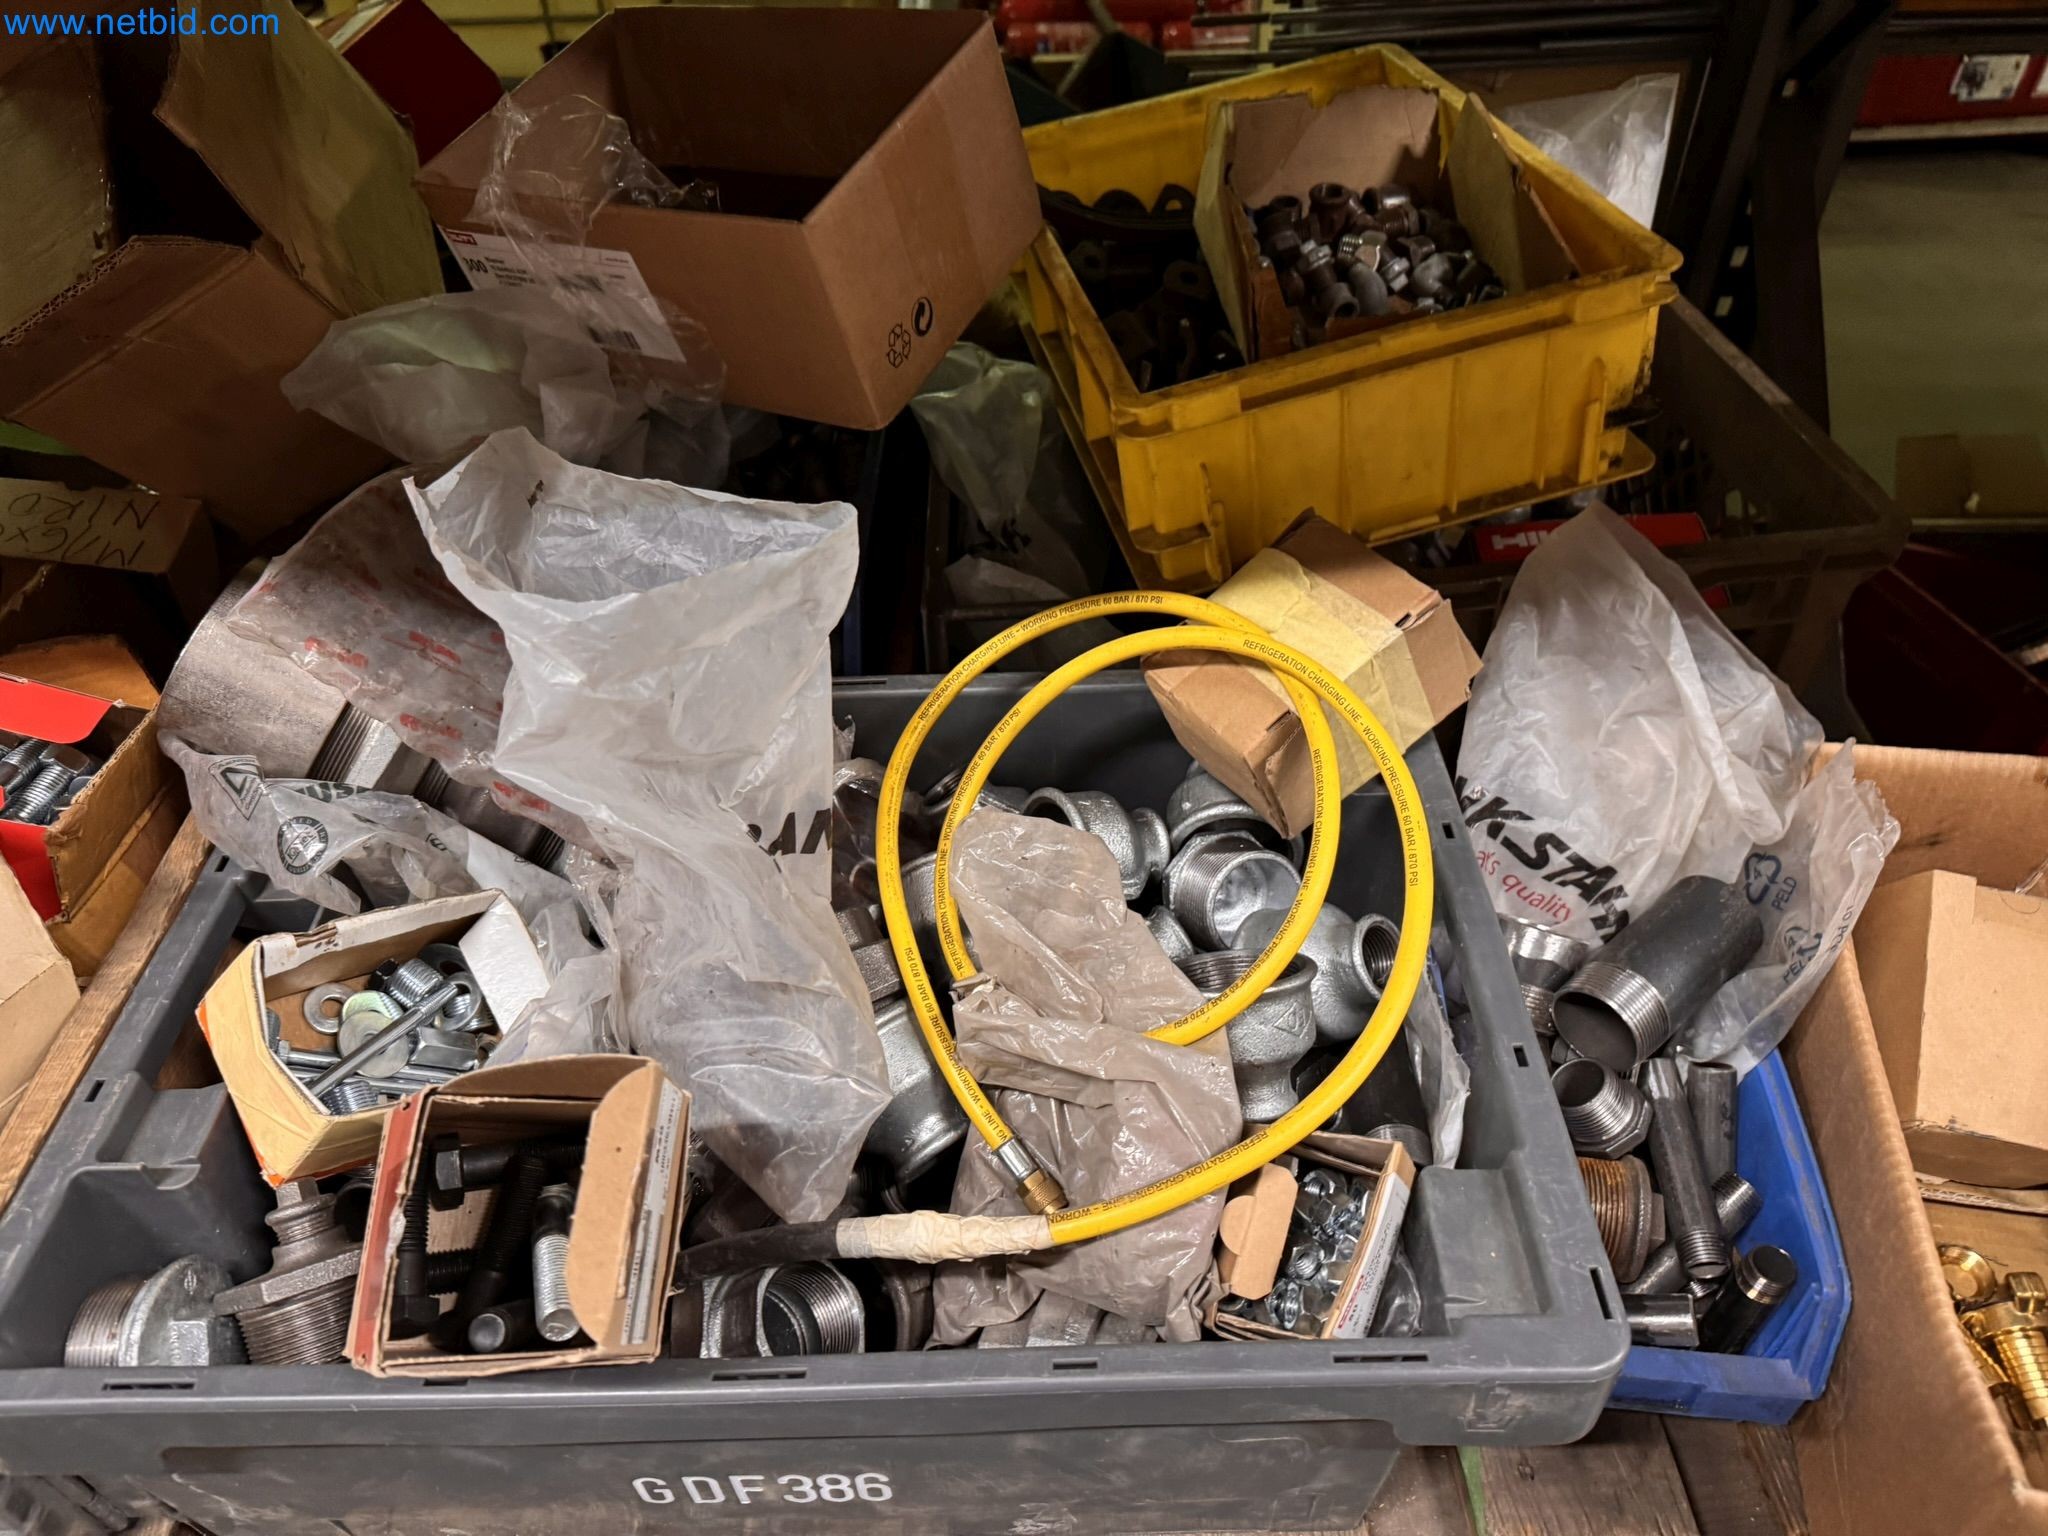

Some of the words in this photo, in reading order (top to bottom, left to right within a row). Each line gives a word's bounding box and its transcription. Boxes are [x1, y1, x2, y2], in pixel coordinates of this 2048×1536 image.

[917, 669, 962, 722] REFRIGERATION
[961, 641, 999, 673] CHARGING
[997, 630, 1016, 648] LINE
[1020, 609, 1059, 633] WORKING
[1058, 598, 1102, 617] PRESSURE
[1102, 596, 1113, 605] 60
[1113, 595, 1130, 604] BAR
[1135, 595, 1149, 604] 870
[1149, 595, 1163, 605] PSI
[1242, 639, 1309, 676] REFRIGERATION
[1307, 670, 1347, 707] CHARGING
[1009, 707, 1022, 722] PSI
[1343, 703, 1362, 724] LINE
[999, 720, 1011, 733] 870
[983, 735, 999, 752] BAR
[1361, 725, 1391, 768] WORKING
[977, 750, 987, 761] 60
[955, 761, 981, 802] PRESSURE
[1312, 748, 1325, 820] REFRIGERATION
[1385, 764, 1410, 815] PRESSURE
[942, 800, 961, 841] WORKING
[1402, 815, 1412, 828] 60
[1307, 820, 1323, 874] CHARGING
[1404, 827, 1416, 847] BAR
[939, 848, 949, 867] LINE
[1408, 853, 1418, 869] 870
[1300, 872, 1314, 892] LINE
[1408, 870, 1419, 887] PSI
[937, 868, 947, 912] CHARGING
[1502, 873, 1574, 927] quality
[1771, 875, 1798, 912] PELD
[1273, 898, 1304, 941] WORKING
[939, 911, 965, 972] REFRIGERATION
[904, 946, 915, 962] PSI
[1239, 941, 1280, 985] PRESSURE
[908, 962, 922, 979] 870
[918, 983, 935, 1003] BAR
[924, 1001, 938, 1015] 60
[1189, 1007, 1206, 1021] 870
[1173, 1015, 1189, 1030] PSI
[983, 1109, 1006, 1131] LINE
[1185, 1130, 1270, 1179] REFRIGERATION
[777, 1472, 894, 1503] 386
